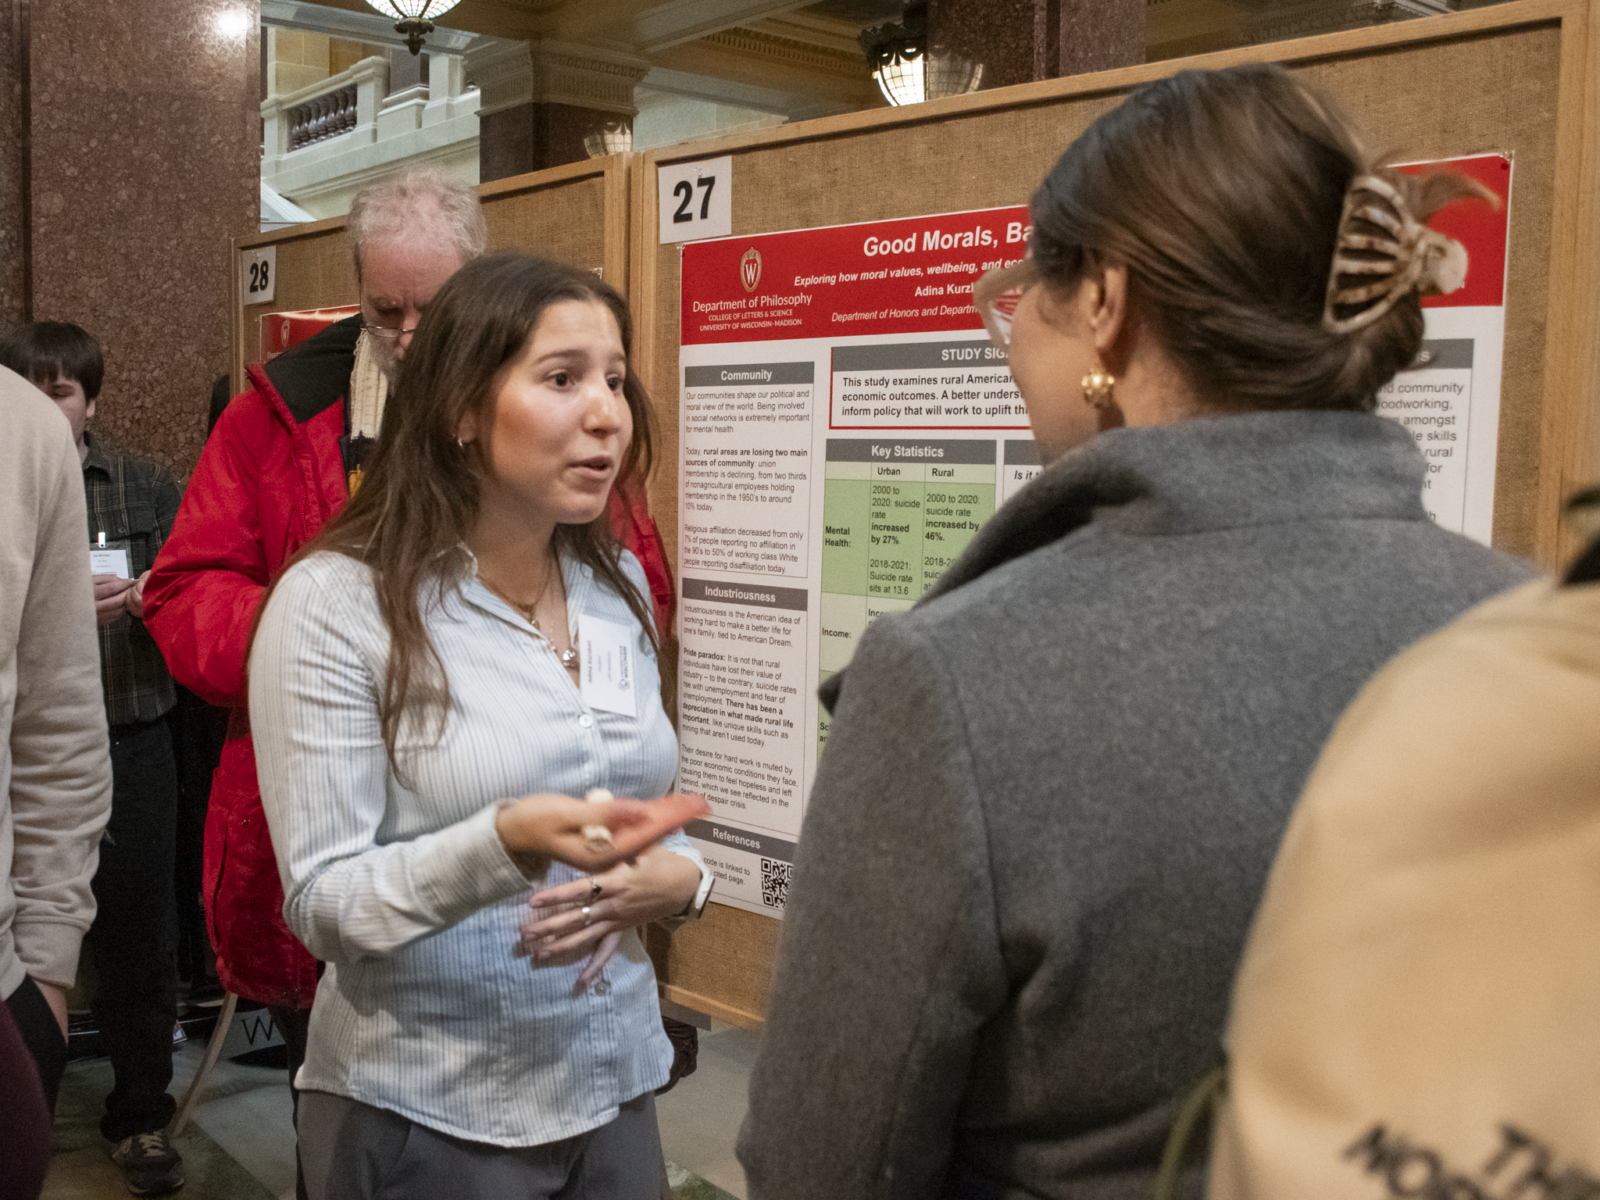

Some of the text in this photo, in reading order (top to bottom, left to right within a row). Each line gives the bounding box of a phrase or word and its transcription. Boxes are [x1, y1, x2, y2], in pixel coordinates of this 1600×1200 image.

[672, 176, 716, 224] 27
[863, 233, 916, 256] Good
[249, 261, 269, 292] 28
[745, 263, 757, 284] W
[794, 274, 836, 286] Exploring
[838, 272, 858, 281] how
[860, 268, 888, 279] moral
[981, 259, 1002, 271] and
[914, 285, 944, 296] Adina
[693, 292, 812, 313] Department of Philosophy
[708, 313, 731, 321] COLLEGE
[741, 311, 763, 319] LETTERS
[770, 308, 792, 316] SCIENCE
[831, 311, 877, 322] Department
[878, 308, 888, 318] of
[888, 308, 919, 318] Honors
[921, 306, 938, 316] and
[699, 323, 730, 331] UNIVERSITY
[740, 318, 802, 328] WISCONSIN-MADISON
[941, 348, 981, 360] STUDY
[720, 369, 772, 381] Community
[842, 377, 861, 386] This
[864, 376, 890, 388] study
[892, 376, 938, 385] examines
[940, 374, 964, 384] rural
[1398, 382, 1463, 395] community
[736, 391, 756, 399] shape
[770, 390, 794, 398] political
[842, 393, 886, 401] economic
[941, 389, 948, 399] A
[951, 390, 980, 399] better
[717, 402, 724, 410] of
[756, 401, 776, 411] Being
[841, 406, 870, 415] inform
[873, 406, 901, 417] policy
[904, 406, 922, 415] that
[925, 405, 941, 415] will
[944, 405, 968, 415] work
[971, 405, 982, 415] to
[984, 404, 1011, 416] uplift
[691, 414, 708, 422] social
[744, 414, 776, 422] extremely
[1404, 415, 1456, 427] amongst
[1427, 431, 1457, 441] skills
[752, 448, 773, 458] losing
[871, 445, 944, 459] Key Statistics
[1425, 448, 1453, 457] rural
[877, 467, 900, 475] Urban
[931, 467, 954, 476] Rural
[1425, 462, 1442, 473] for
[1014, 470, 1022, 480] Is
[1025, 470, 1033, 480] it
[872, 485, 891, 494] 2000
[926, 493, 946, 502] 2000
[948, 495, 956, 503] to
[894, 500, 920, 508] suicide
[925, 507, 971, 516] suicide rate
[825, 526, 850, 535] Mental
[871, 523, 909, 532] increased
[925, 521, 980, 531] increased by
[870, 534, 880, 545] by
[869, 571, 896, 581] Suicide
[704, 586, 776, 602] Industriousness
[868, 584, 908, 595] sits at 13.6
[751, 658, 764, 666] that
[726, 699, 744, 709] There
[746, 702, 758, 711] has
[760, 704, 777, 714] been
[690, 758, 703, 766] poor
[704, 761, 732, 773] economic
[734, 767, 765, 780] conditions
[767, 773, 781, 785] they
[712, 828, 760, 848] References
[703, 857, 717, 866] code
[725, 862, 742, 873] linked
[713, 870, 727, 879] cited
